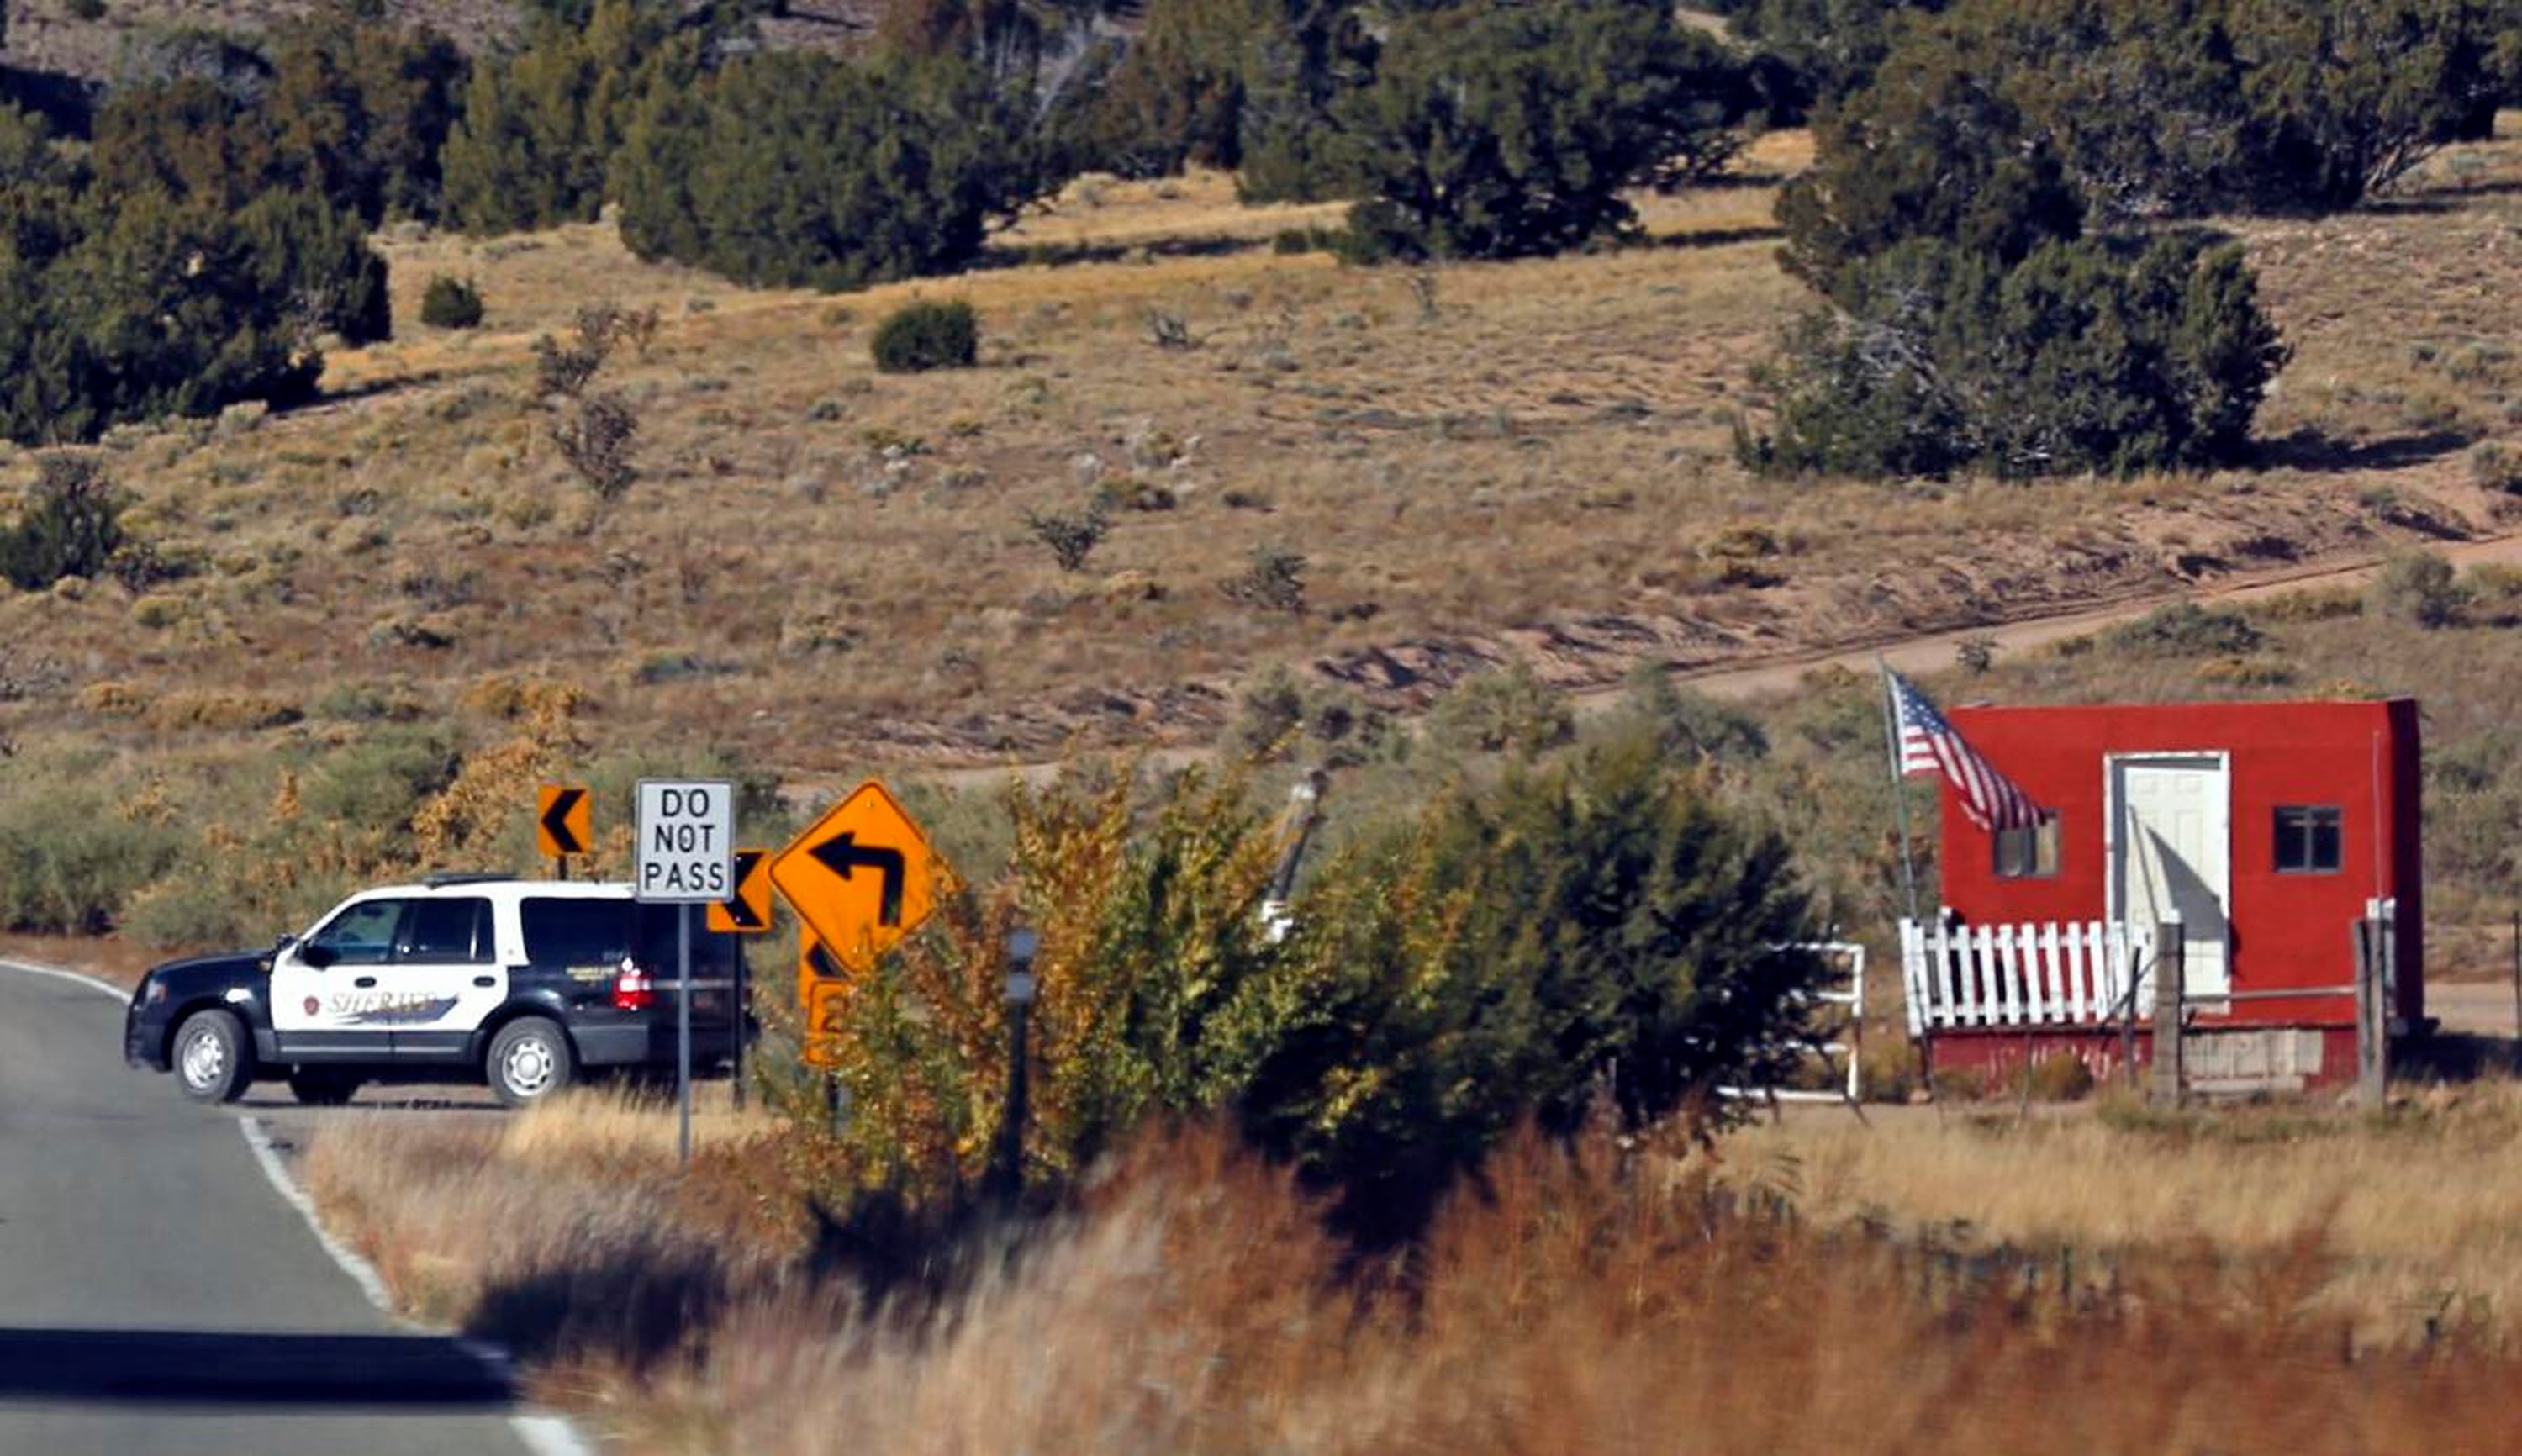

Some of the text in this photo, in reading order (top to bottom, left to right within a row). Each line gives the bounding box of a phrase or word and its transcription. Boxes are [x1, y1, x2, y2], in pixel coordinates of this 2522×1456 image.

[662, 789, 710, 818] DO
[655, 824, 715, 853] NOT
[645, 862, 724, 891] PASS
